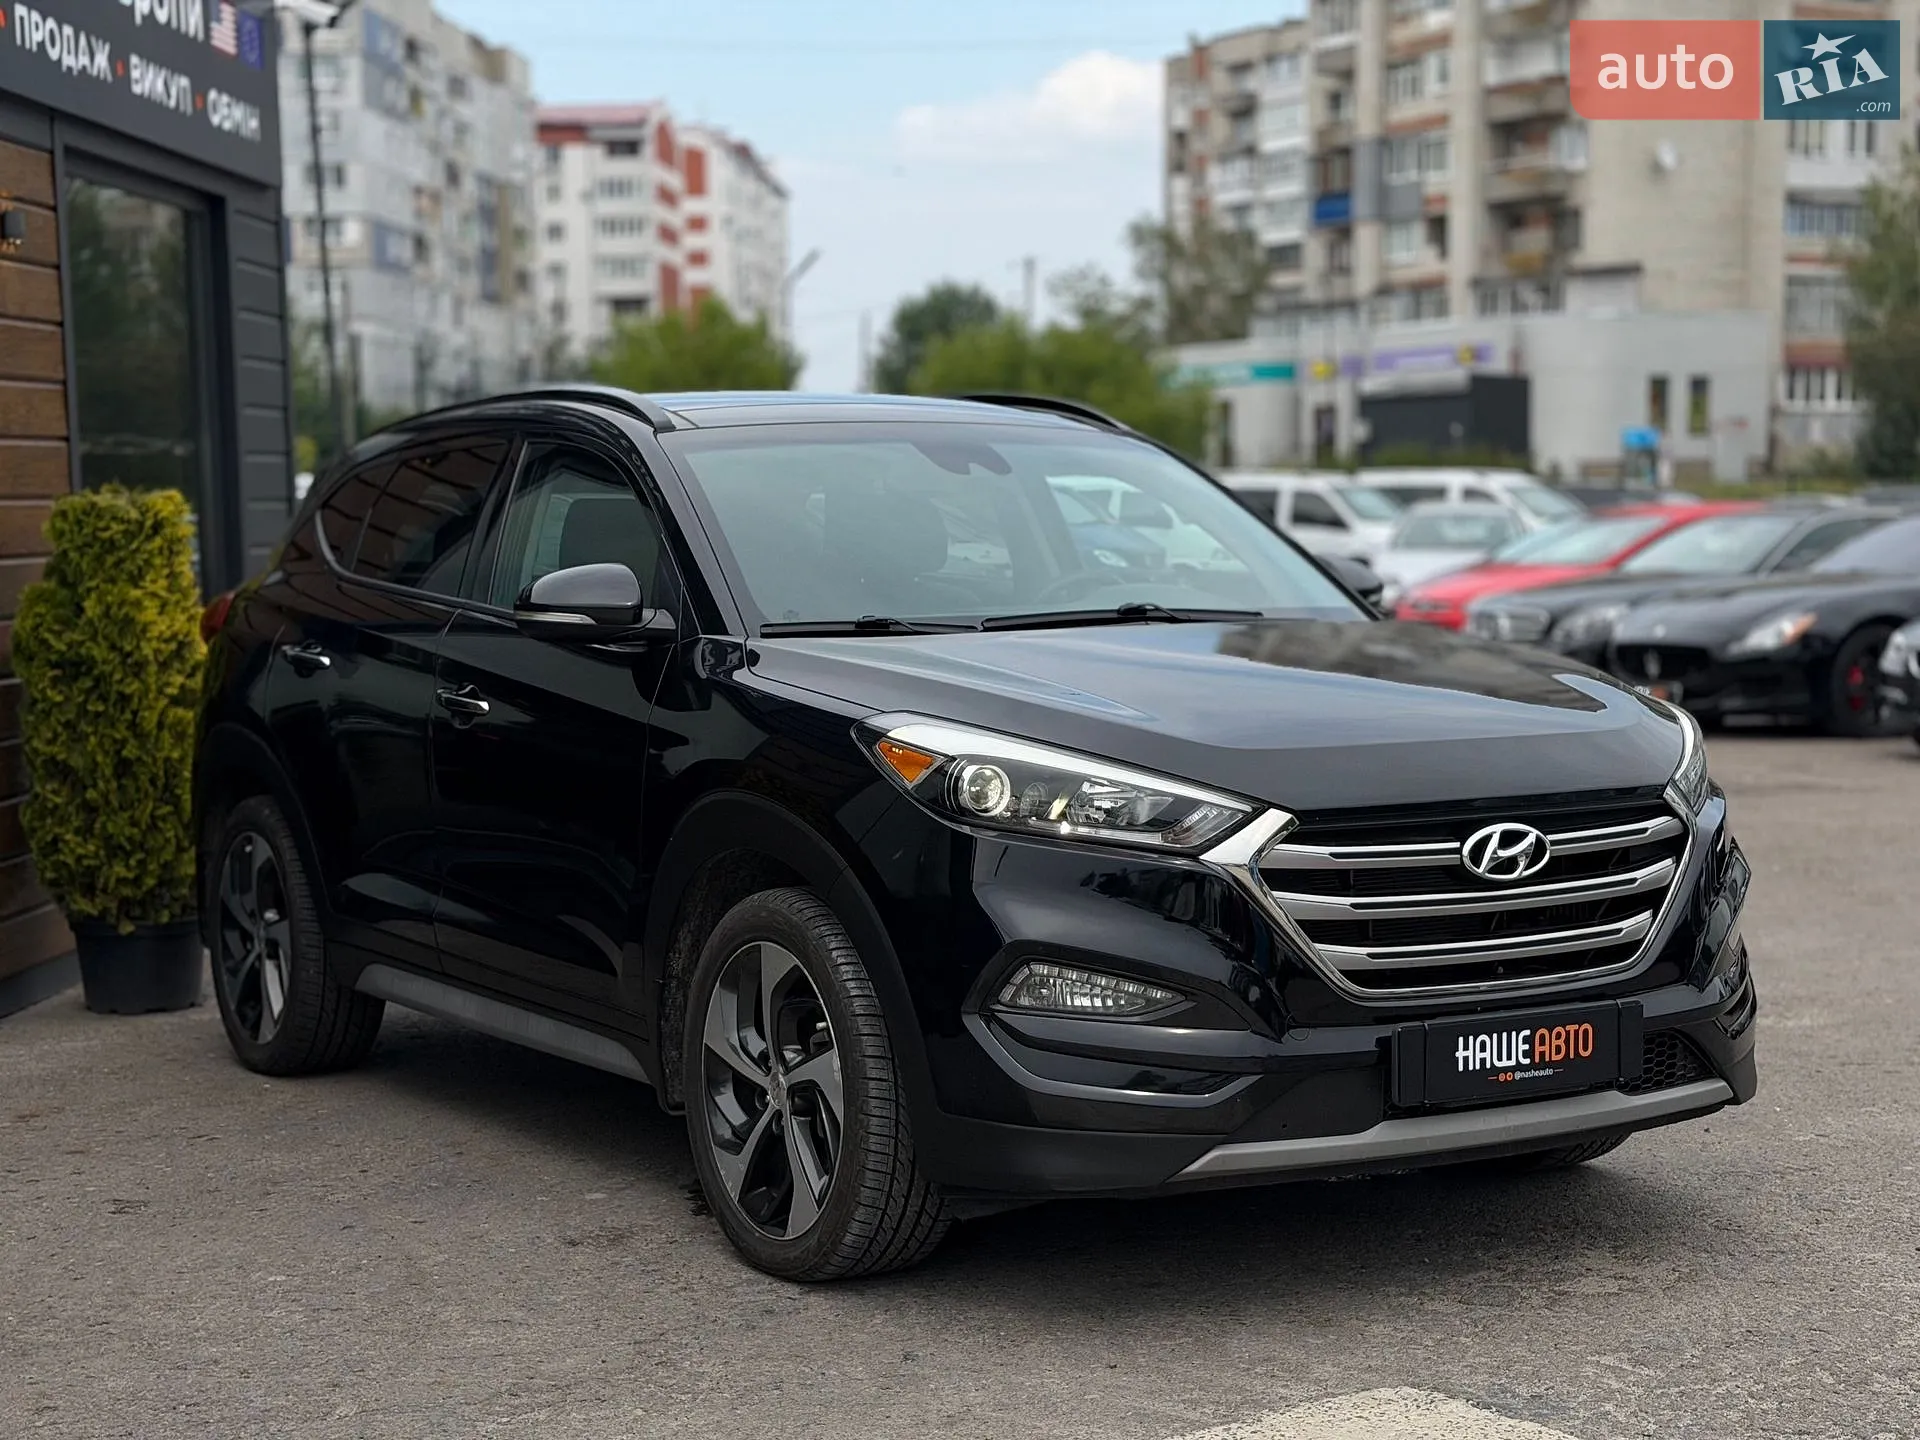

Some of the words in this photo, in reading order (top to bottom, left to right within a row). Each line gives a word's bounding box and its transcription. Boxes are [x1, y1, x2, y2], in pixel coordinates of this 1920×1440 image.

[14, 2, 113, 84] ПРОДАЖ
[129, 53, 193, 118] ВИКУП
[206, 87, 261, 142] ОБМІН
[1514, 1067, 1554, 1081] @nasheauto
